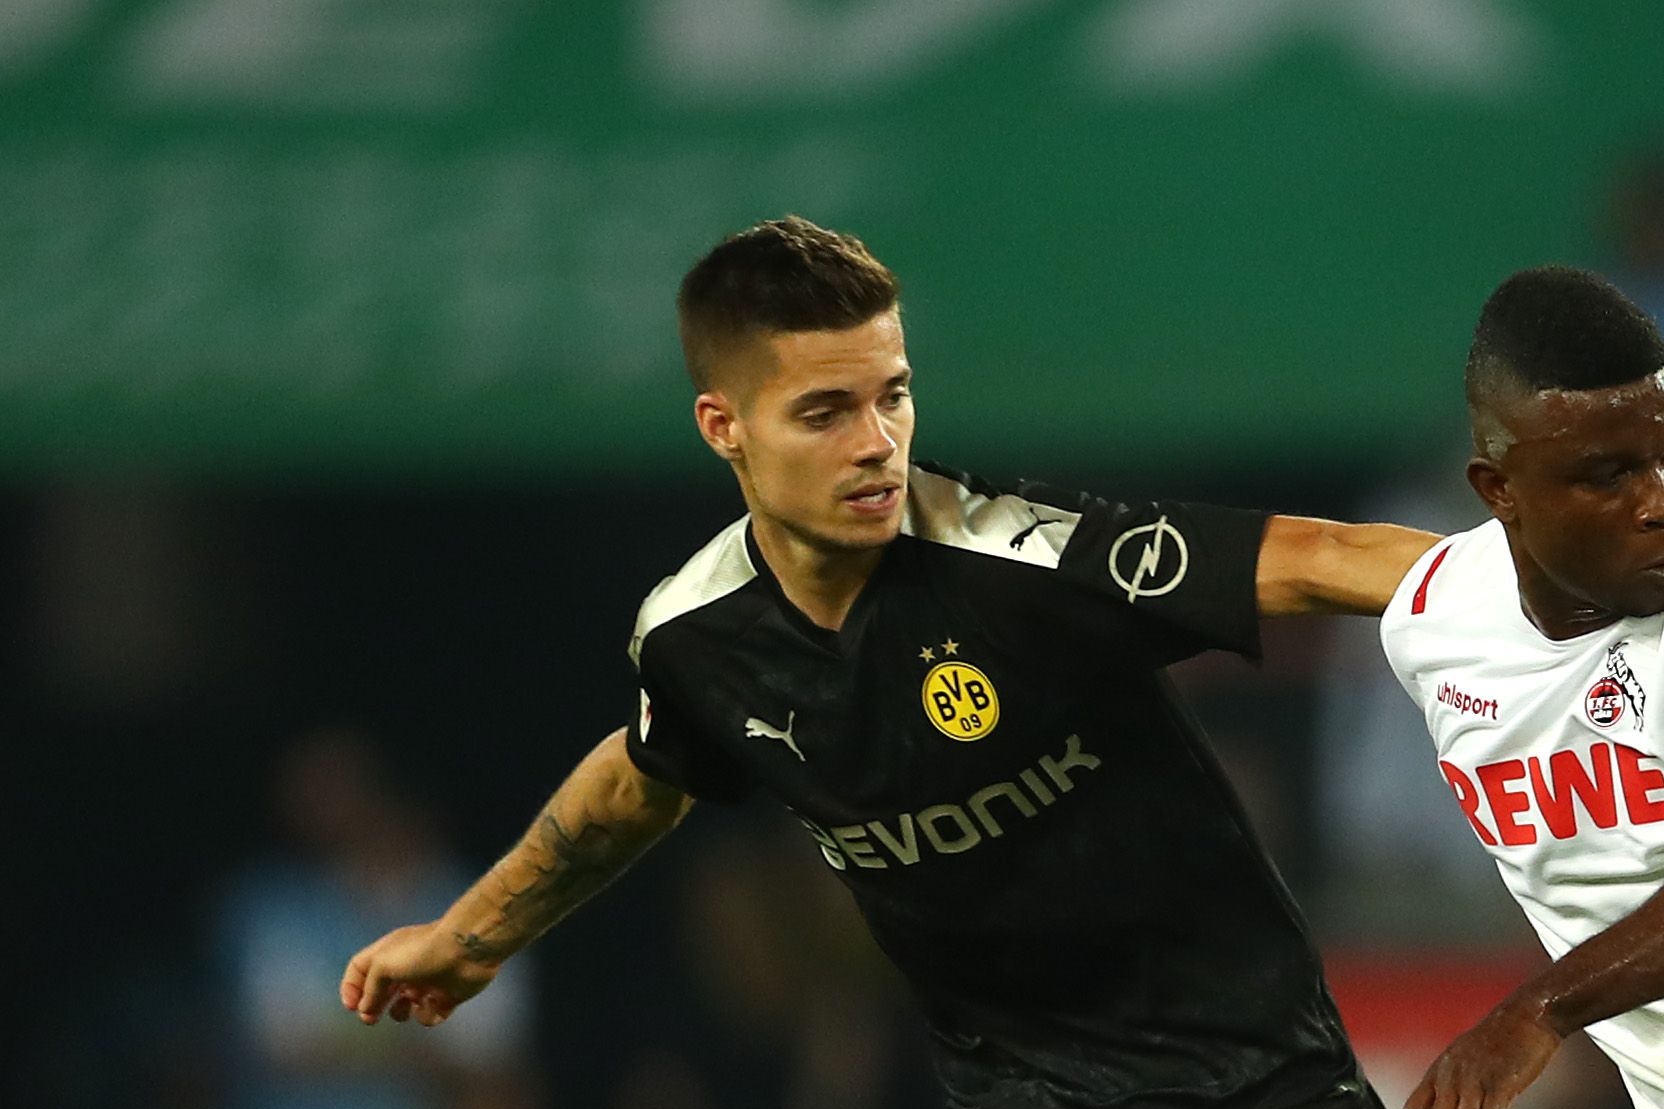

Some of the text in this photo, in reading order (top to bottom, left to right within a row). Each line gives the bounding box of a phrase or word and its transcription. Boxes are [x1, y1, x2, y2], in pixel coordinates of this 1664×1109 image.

[932, 669, 990, 722] BVB
[1437, 681, 1498, 721] uhlsport
[960, 713, 982, 732] 09
[830, 734, 1101, 869] EVONIK
